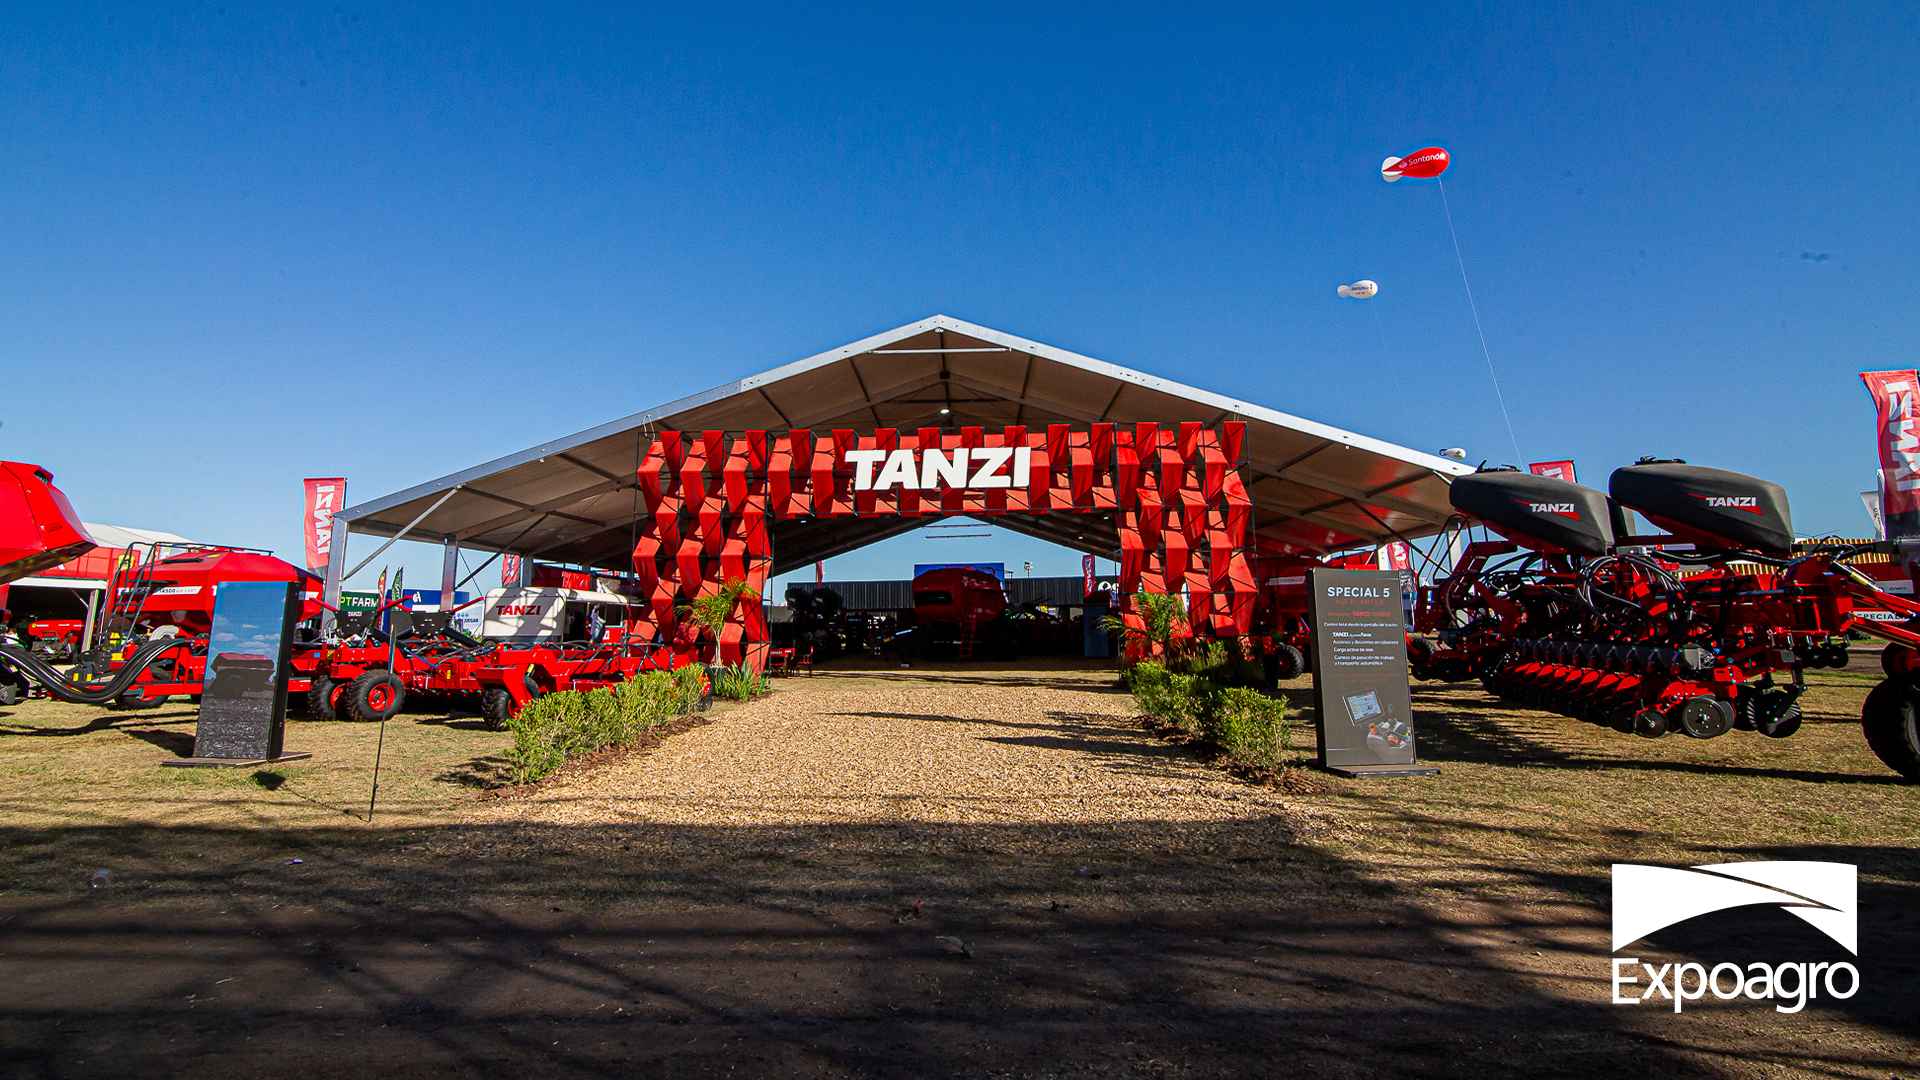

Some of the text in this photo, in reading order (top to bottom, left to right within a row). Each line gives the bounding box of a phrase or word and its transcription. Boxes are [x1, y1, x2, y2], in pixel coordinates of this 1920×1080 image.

[844, 446, 1031, 490] TANZI
[1706, 496, 1757, 507] TANZI
[1529, 503, 1575, 513] TANZI
[1327, 586, 1390, 598] SPECIAL 5
[1350, 598, 1385, 606] PLANTER
[495, 604, 541, 616] TANZI
